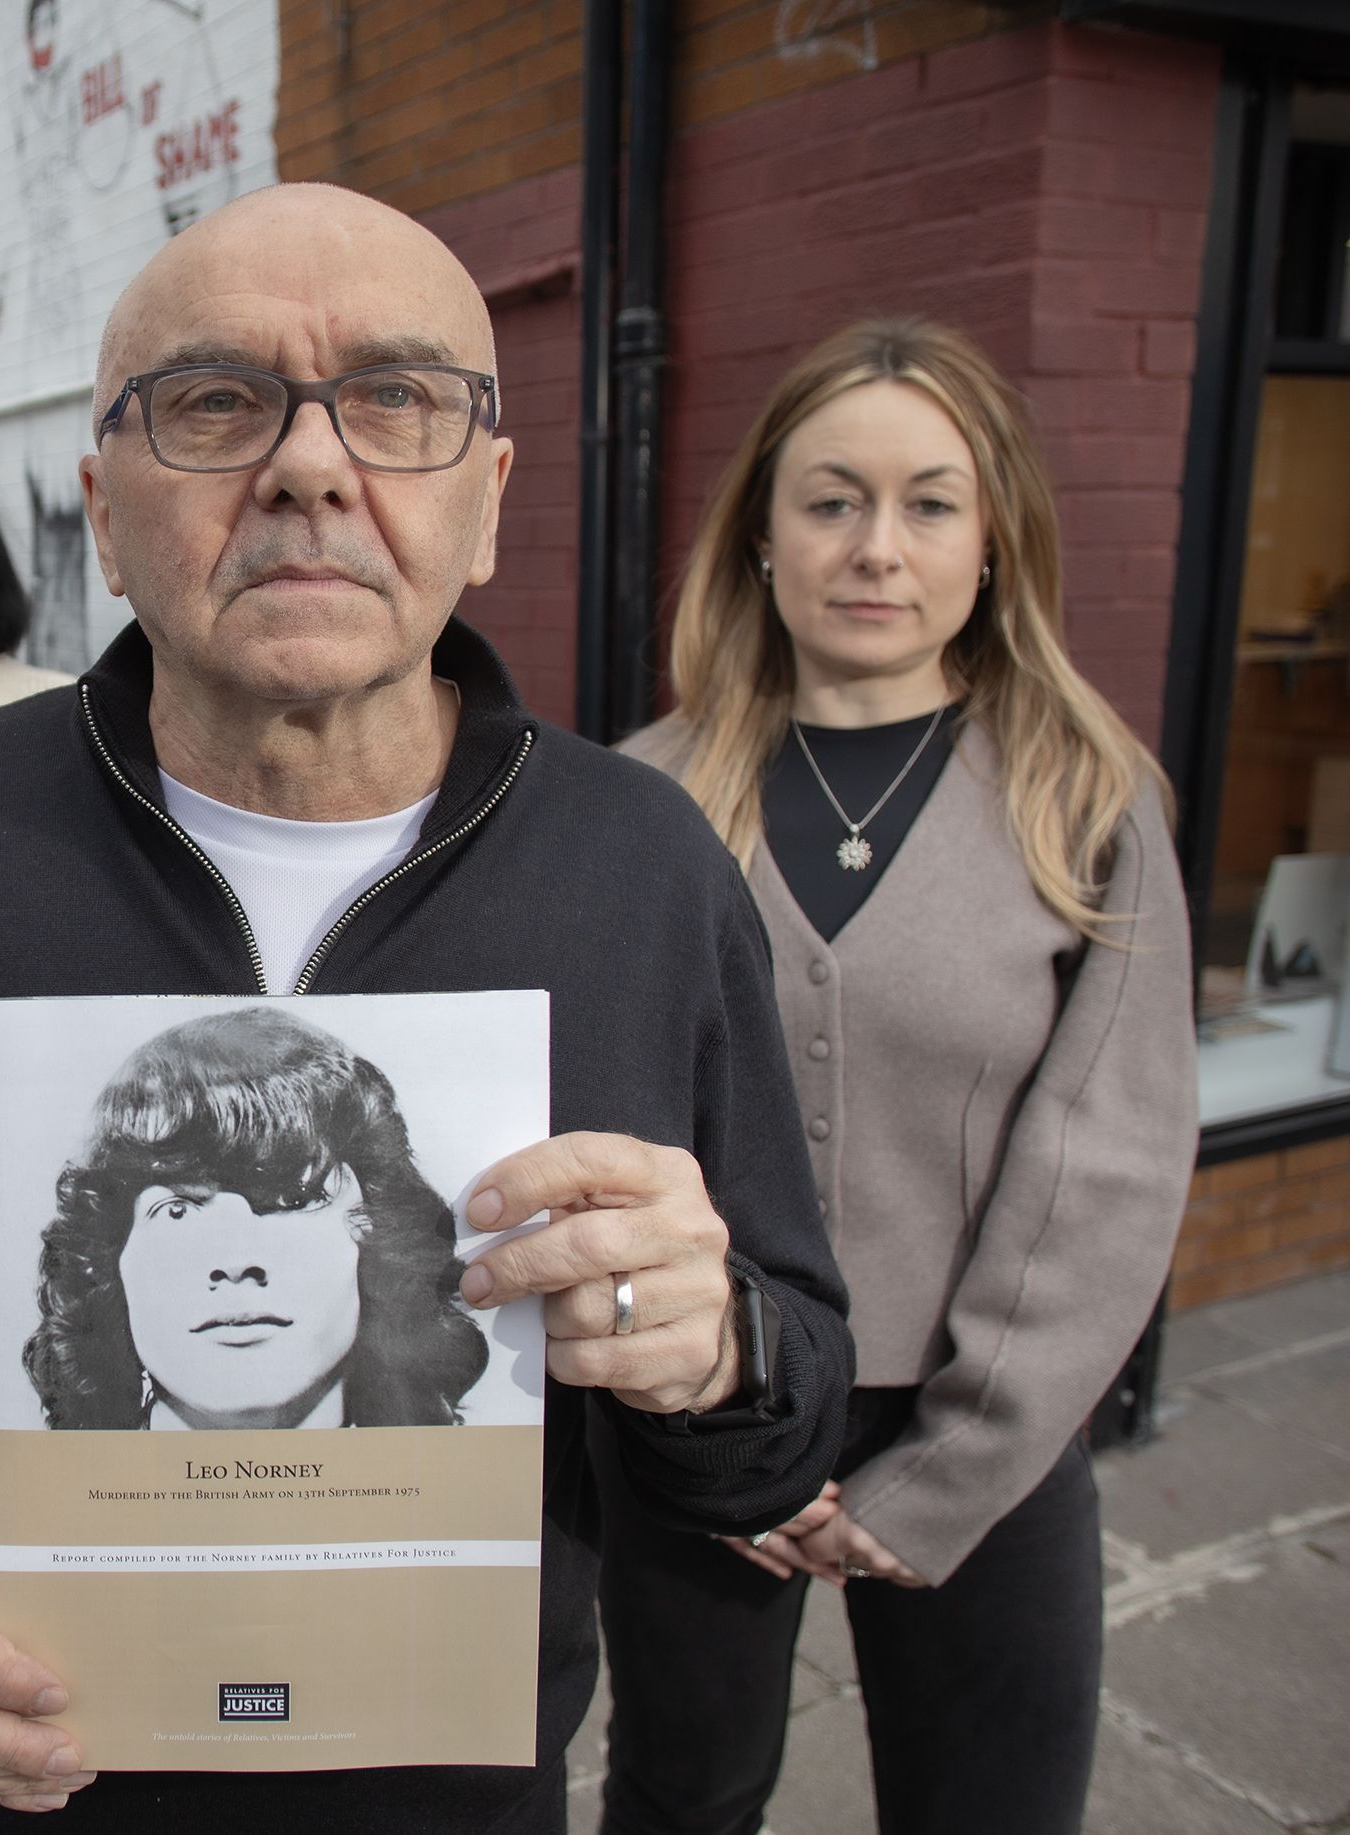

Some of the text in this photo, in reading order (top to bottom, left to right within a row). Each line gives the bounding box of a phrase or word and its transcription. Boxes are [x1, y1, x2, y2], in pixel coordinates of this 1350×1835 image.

[154, 97, 241, 189] SHAME
[395, 1487, 420, 1498] 1975
[223, 1699, 285, 1711] JUSTICE
